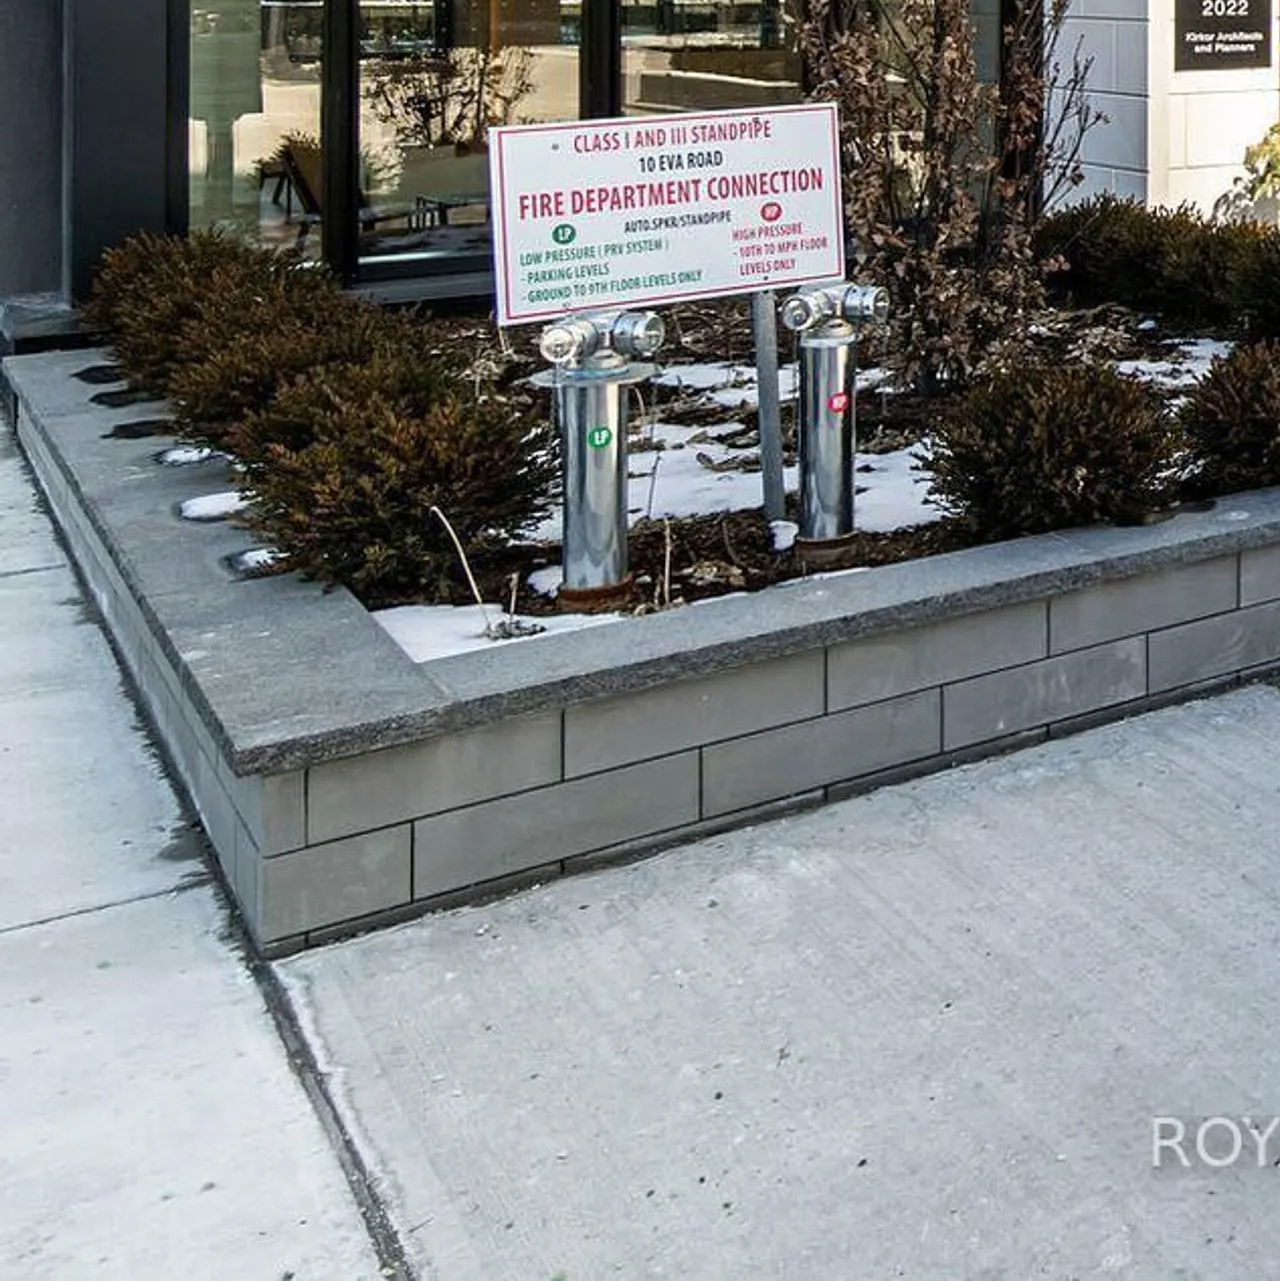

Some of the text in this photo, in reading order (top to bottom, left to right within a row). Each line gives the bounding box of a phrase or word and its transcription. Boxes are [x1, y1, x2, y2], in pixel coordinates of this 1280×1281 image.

[1194, 43, 1256, 53] and Planners
[574, 120, 772, 153] CLASS I AND III STANDPIPE
[639, 150, 723, 172] 10 EVA ROAD
[519, 168, 823, 219] FIRE DEPARTMENT CONNECTION
[732, 222, 802, 241] HIGH PRESSURE
[519, 253, 542, 266] LOW
[544, 245, 595, 263] PRESSURE
[626, 238, 662, 253] SYSTEM
[740, 245, 763, 258] 10TH
[764, 243, 775, 255] TO
[800, 237, 828, 250] FLOOR
[575, 262, 610, 277] LEVELS
[740, 259, 796, 275] LEVELS ONLY
[574, 283, 587, 297] TO
[589, 280, 608, 295] 9TH
[610, 276, 640, 292] FLOOR
[643, 273, 676, 288] LEVELS
[679, 270, 703, 284] ONLY
